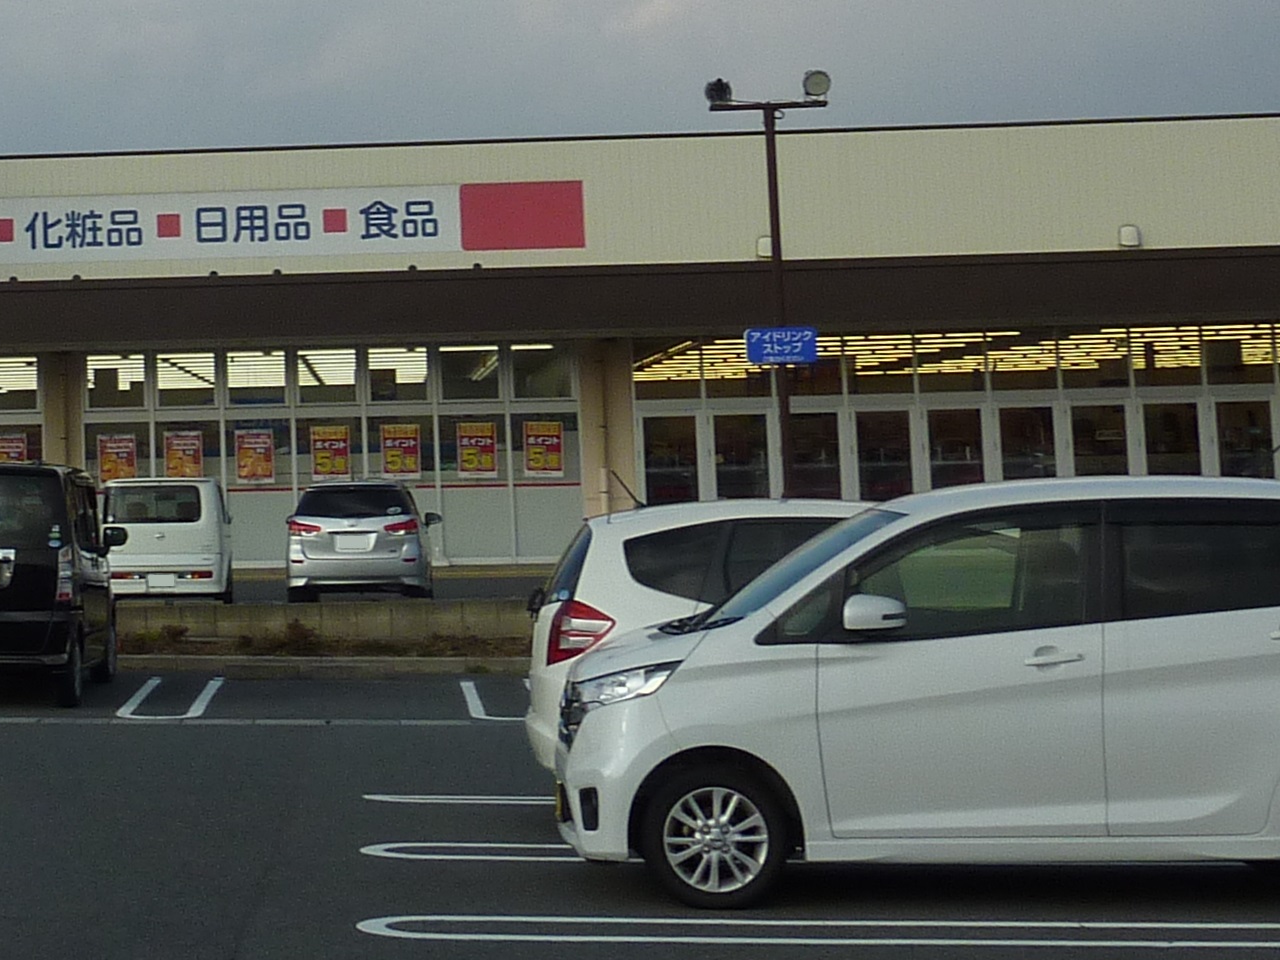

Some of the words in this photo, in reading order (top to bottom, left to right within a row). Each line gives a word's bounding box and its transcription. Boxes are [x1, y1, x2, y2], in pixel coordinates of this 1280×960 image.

[24, 209, 143, 250] 化粧品
[195, 203, 311, 244] 日用品
[358, 200, 439, 240] 食品
